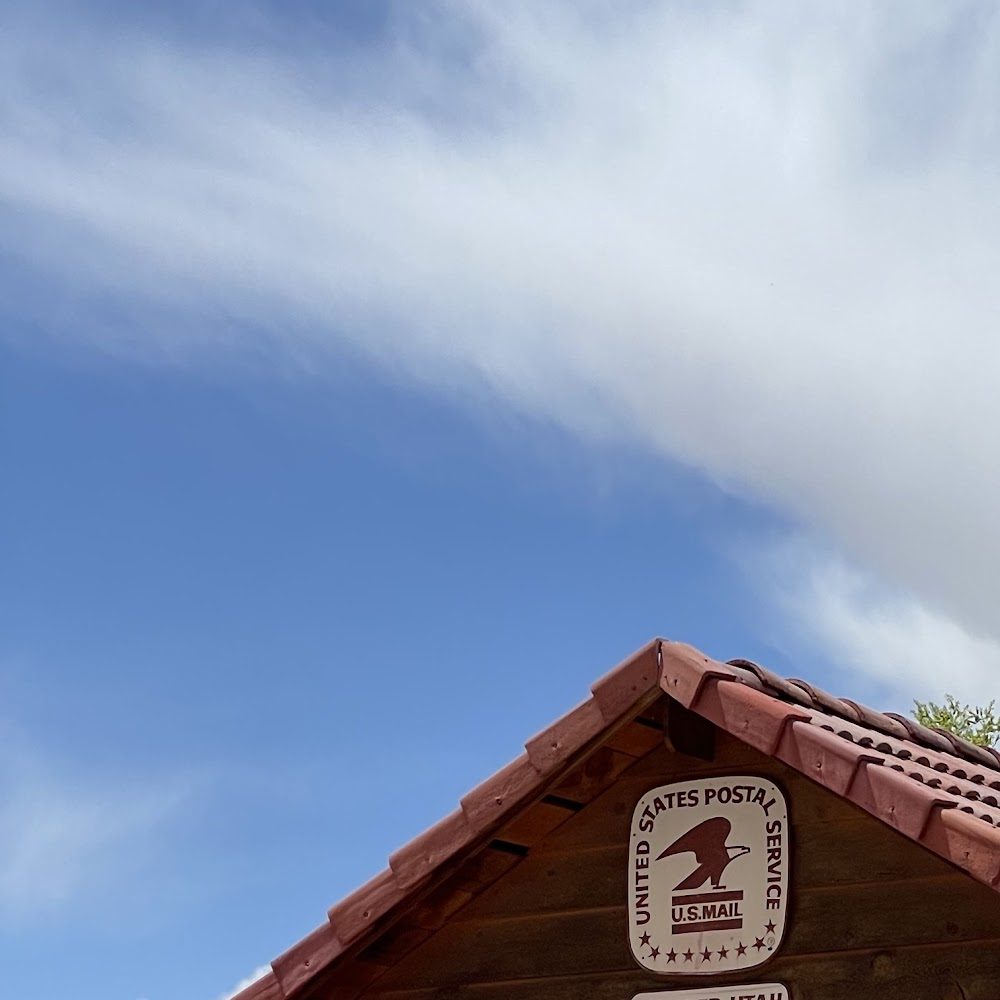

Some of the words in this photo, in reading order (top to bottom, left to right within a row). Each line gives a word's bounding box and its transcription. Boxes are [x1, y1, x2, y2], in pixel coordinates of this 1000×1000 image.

[639, 789, 700, 833] STATES
[704, 785, 777, 817] POSTAL
[635, 840, 651, 926] UNITED
[766, 820, 782, 911] SERVICE
